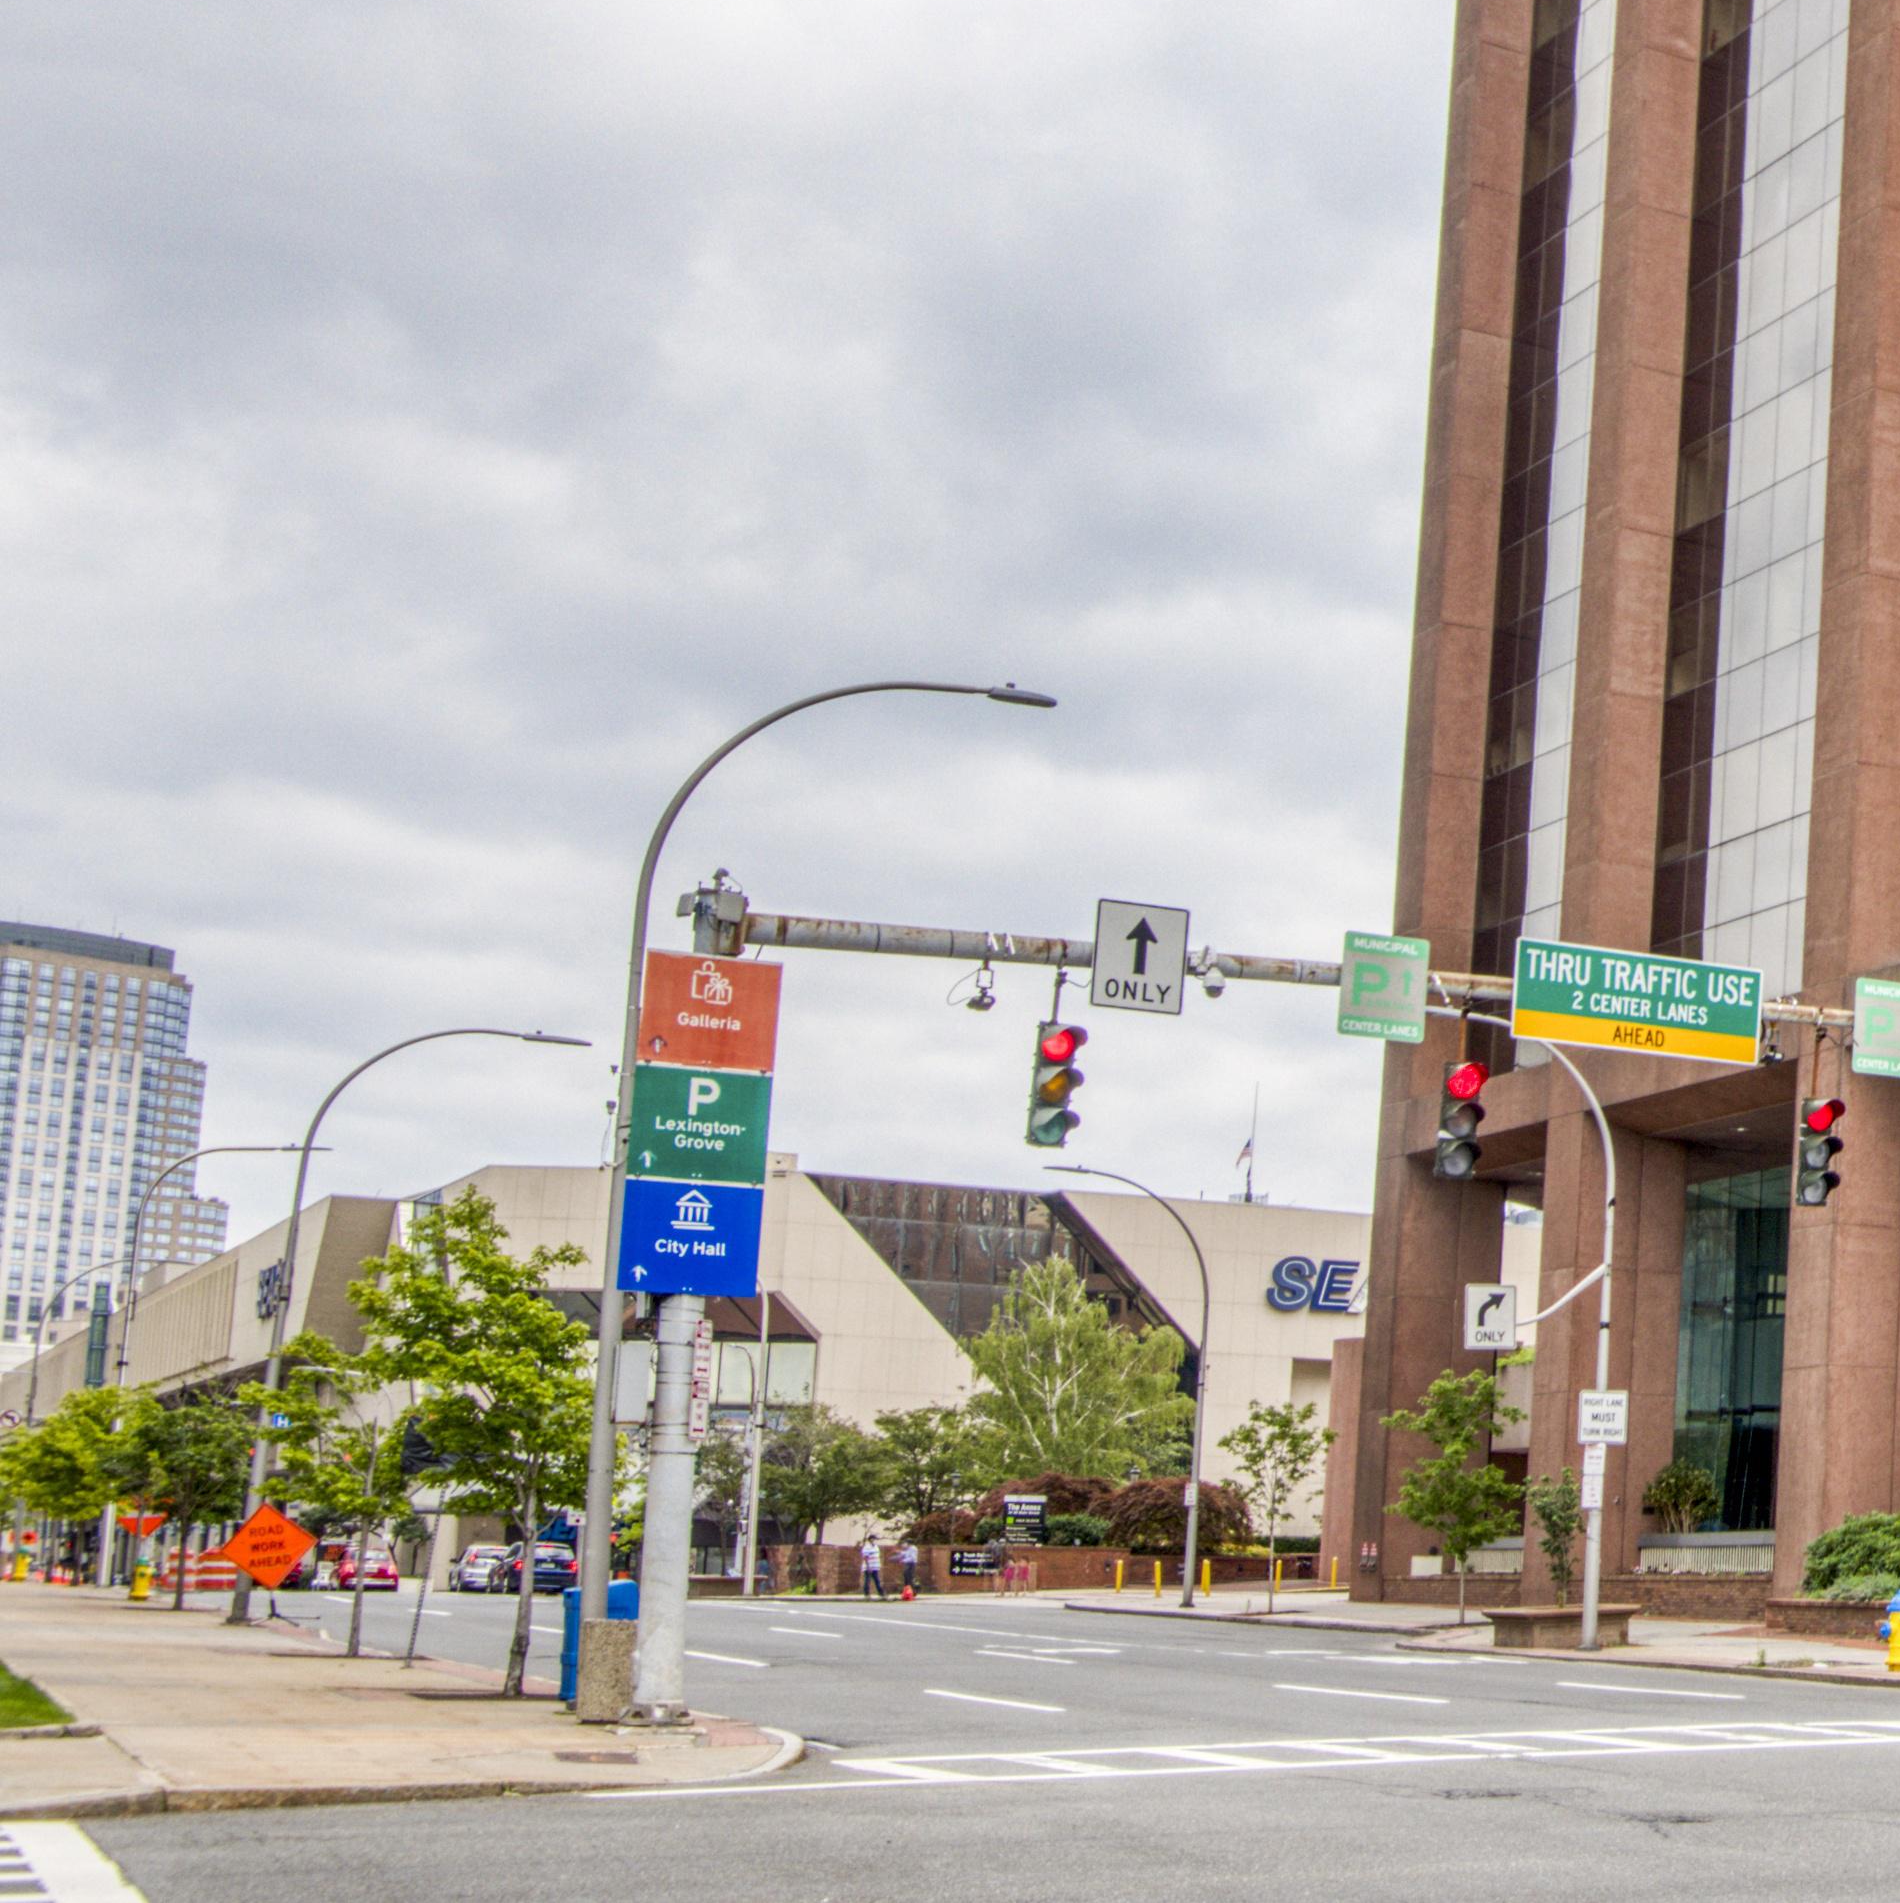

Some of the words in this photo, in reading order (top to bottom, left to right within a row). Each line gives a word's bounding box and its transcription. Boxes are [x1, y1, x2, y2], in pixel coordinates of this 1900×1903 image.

[1353, 938, 1419, 956] MUNICIPAL
[1527, 948, 1590, 987] THRU
[1601, 958, 1696, 1000] TRAFFIC
[1708, 971, 1754, 1008] USE
[1105, 978, 1171, 1005] ONLY
[1572, 992, 1583, 1010] 2
[1590, 993, 1650, 1020] CENTER
[1657, 1001, 1708, 1026] LANES
[677, 1012, 741, 1032] Galleria
[1342, 1019, 1381, 1034] CENTER
[1383, 1024, 1419, 1038] LANES
[1612, 1027, 1665, 1048] AHEAD
[1857, 1057, 1889, 1070] CENTER
[688, 1077, 720, 1114] P
[675, 1134, 725, 1151] Grove
[655, 1239, 688, 1258] City
[693, 1241, 726, 1257] Hall
[1475, 1330, 1506, 1343] ONLY
[1584, 1398, 1604, 1407] RIGHT
[1606, 1399, 1624, 1407] LANE
[277, 1418, 289, 1428] H
[1591, 1412, 1616, 1423] MUST
[1583, 1428, 1601, 1436] TURN
[1603, 1428, 1623, 1437] RIGHT
[250, 1525, 284, 1537] ROAD
[251, 1540, 286, 1552] WORK
[250, 1554, 292, 1568] AHEAD
